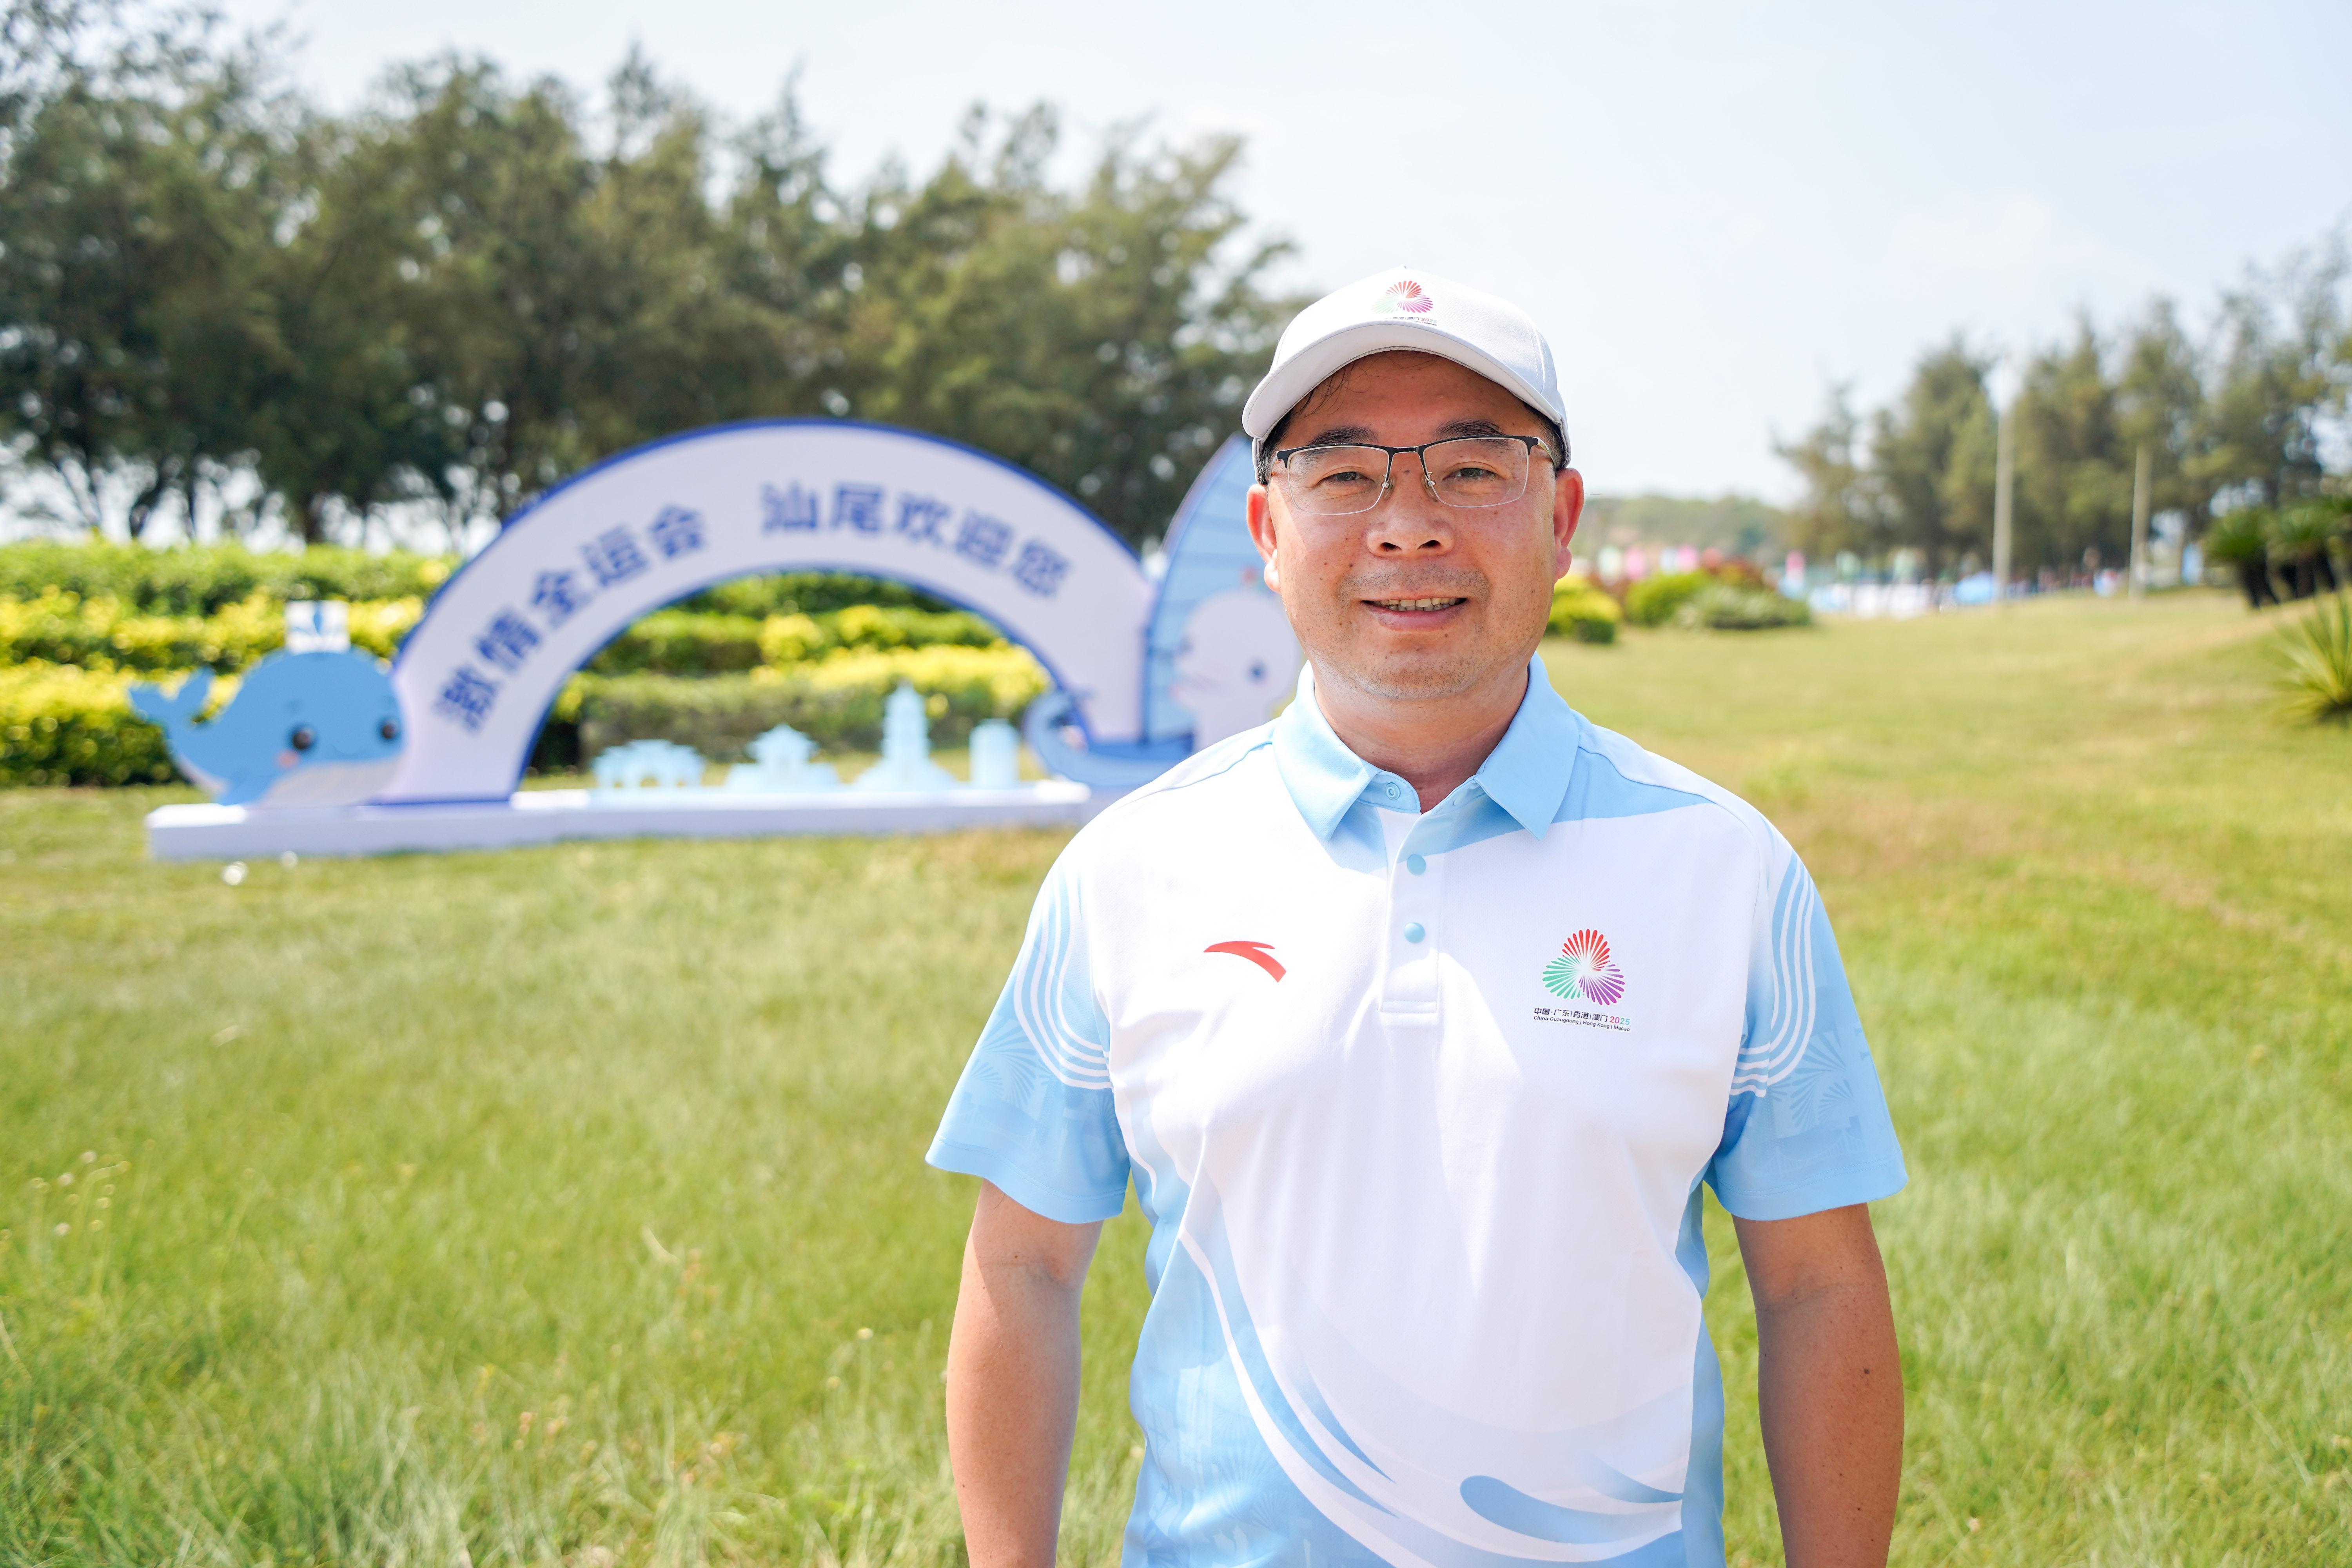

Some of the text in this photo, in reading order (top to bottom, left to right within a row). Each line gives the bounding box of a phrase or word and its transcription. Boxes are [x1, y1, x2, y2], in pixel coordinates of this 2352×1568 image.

[760, 481, 1069, 597] 汕尾欢迎您
[1610, 1016, 1630, 1025] 2025
